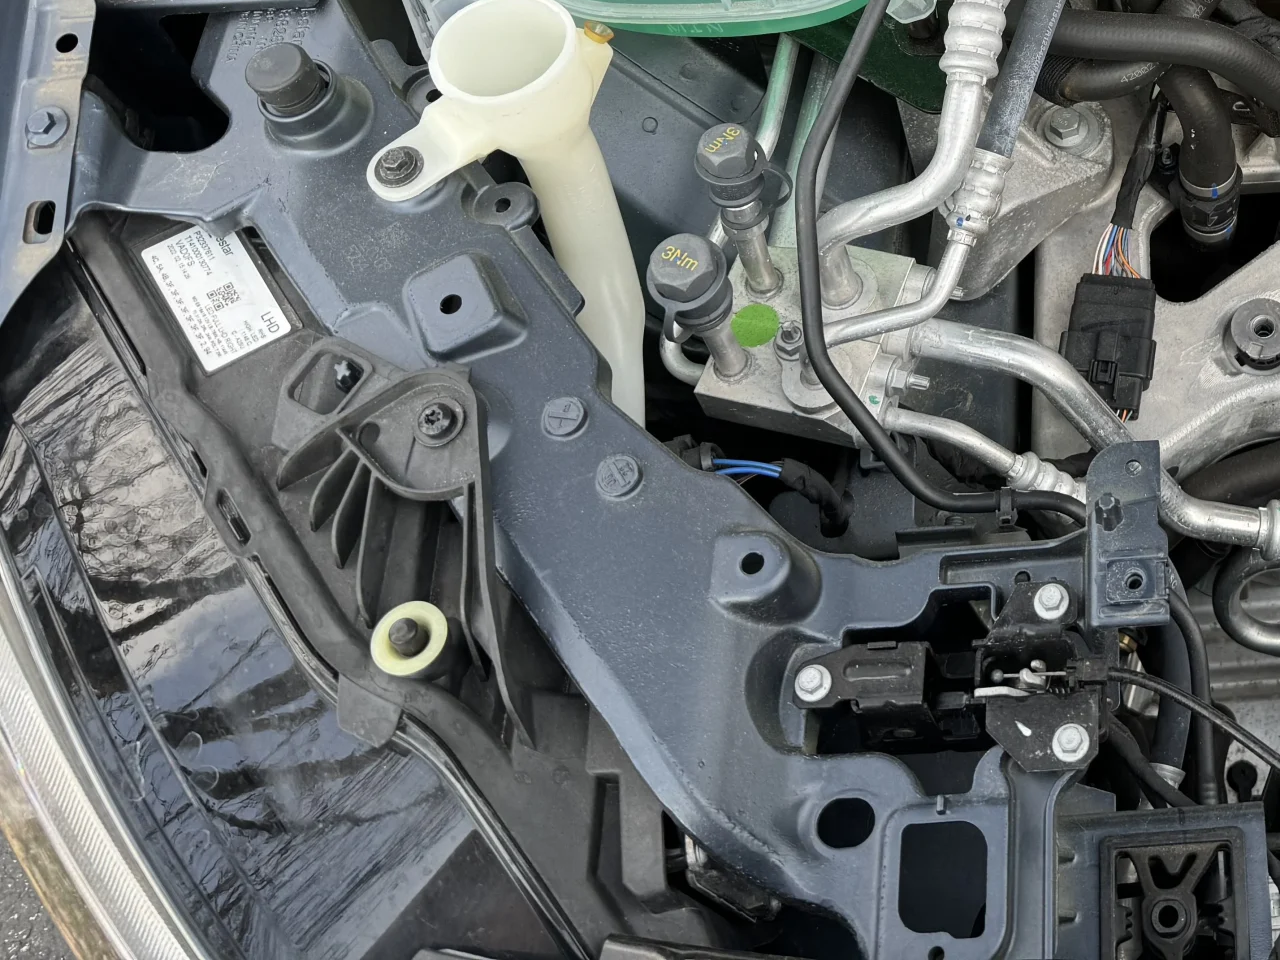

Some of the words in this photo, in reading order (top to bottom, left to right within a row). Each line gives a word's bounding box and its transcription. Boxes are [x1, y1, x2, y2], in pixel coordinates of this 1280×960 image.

[215, 234, 234, 257] estar
[661, 245, 699, 271] 3Nm
[210, 314, 221, 327] FULL
[223, 337, 236, 354] RIGHT
[260, 311, 279, 334] LHD
